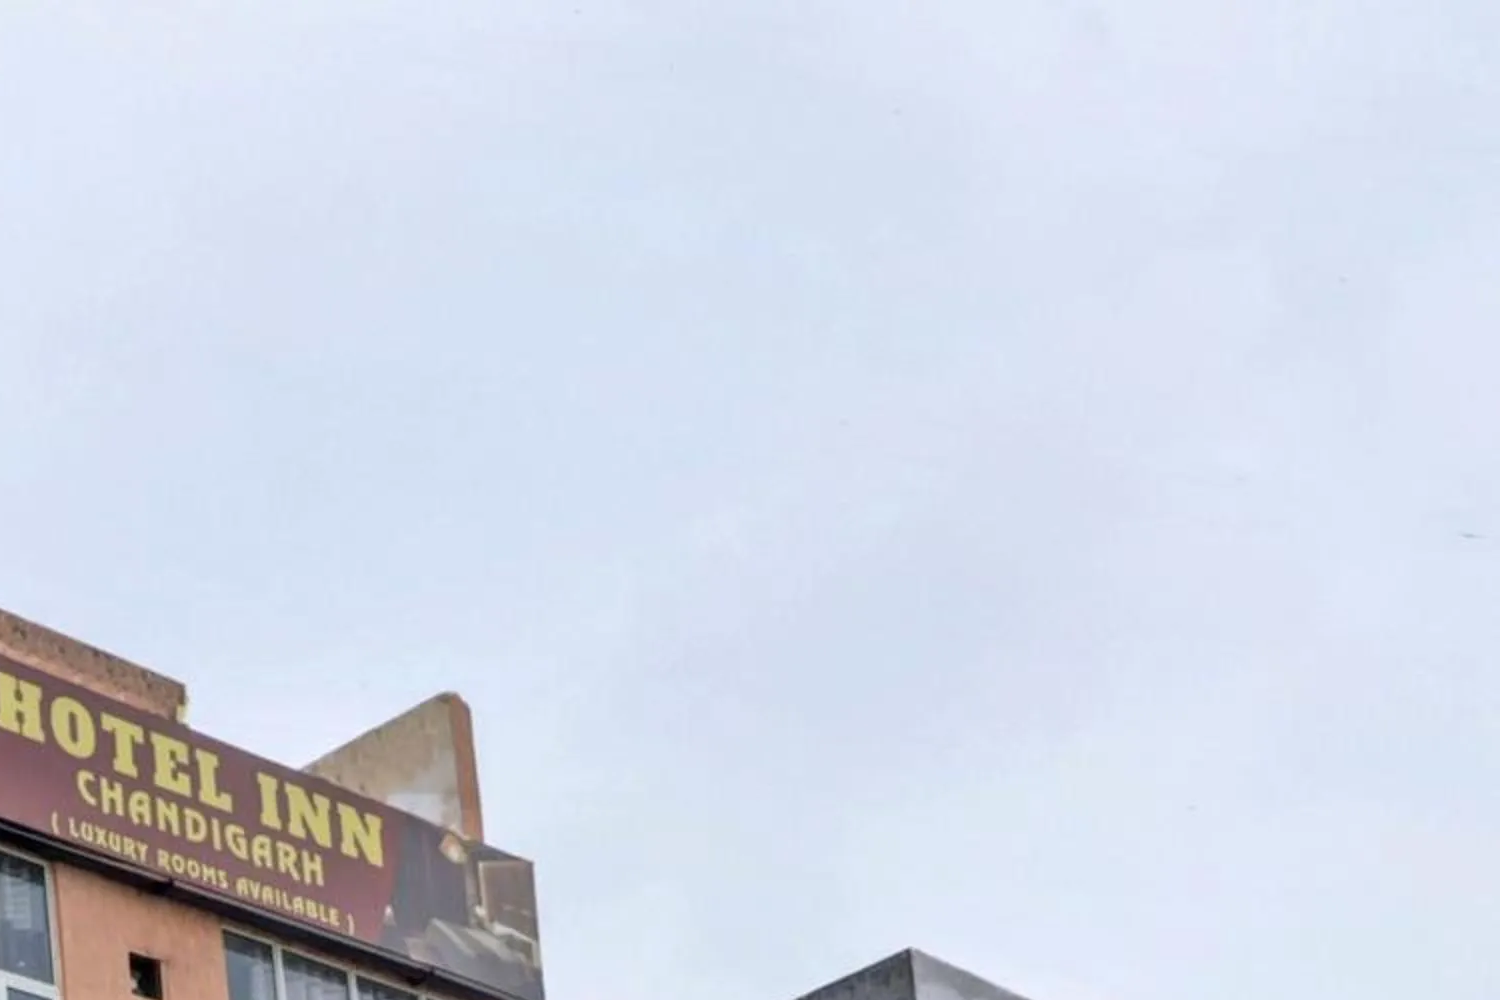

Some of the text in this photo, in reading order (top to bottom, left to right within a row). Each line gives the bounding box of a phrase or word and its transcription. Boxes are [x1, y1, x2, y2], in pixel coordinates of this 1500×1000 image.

[68, 816, 149, 865] LUXURY
[157, 848, 229, 889] ROOMS
[236, 876, 341, 926] AVAILABLE
[76, 769, 324, 887] CHANDIGARH
[257, 771, 384, 868] INN
